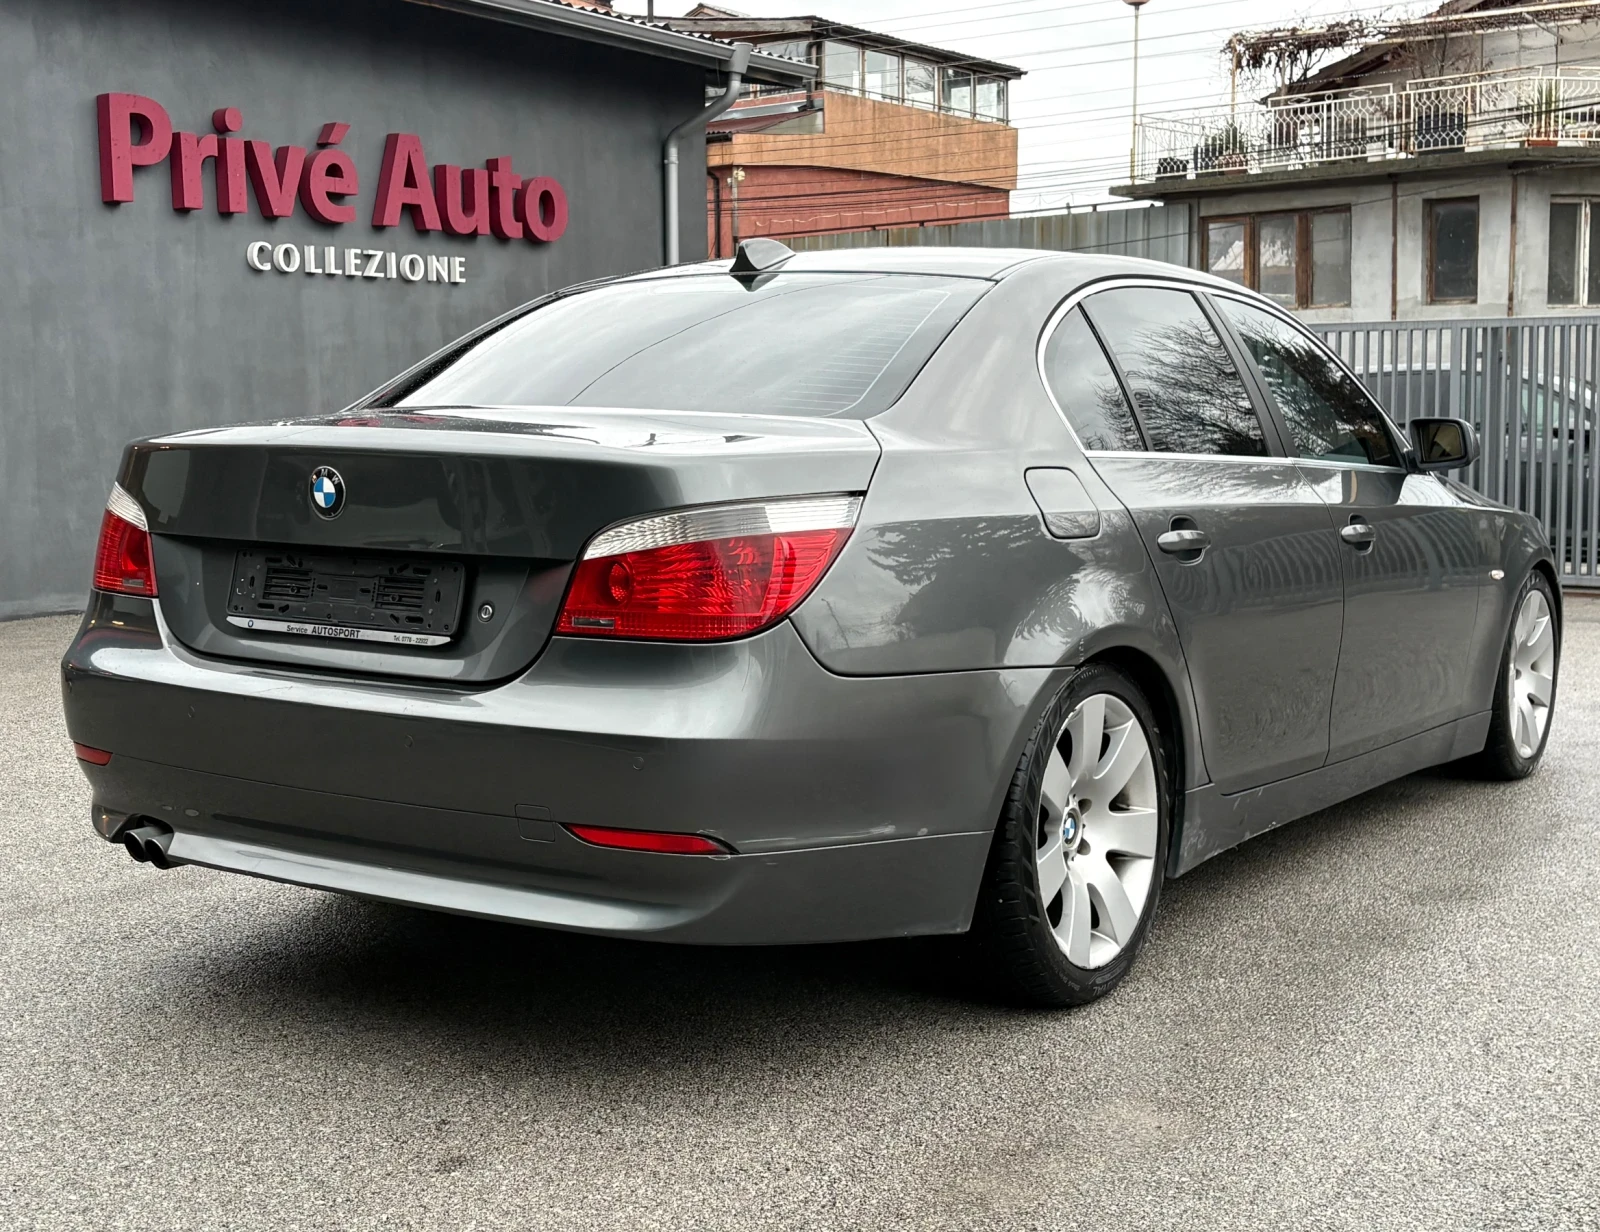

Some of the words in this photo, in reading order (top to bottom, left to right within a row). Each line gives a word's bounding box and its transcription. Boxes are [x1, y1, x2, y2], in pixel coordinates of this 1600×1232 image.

[97, 92, 359, 225] Privé
[371, 132, 569, 242] Auto
[246, 241, 467, 284] COLLEZIONE
[286, 625, 308, 634] Service
[311, 626, 361, 639] AUTOSPORT
